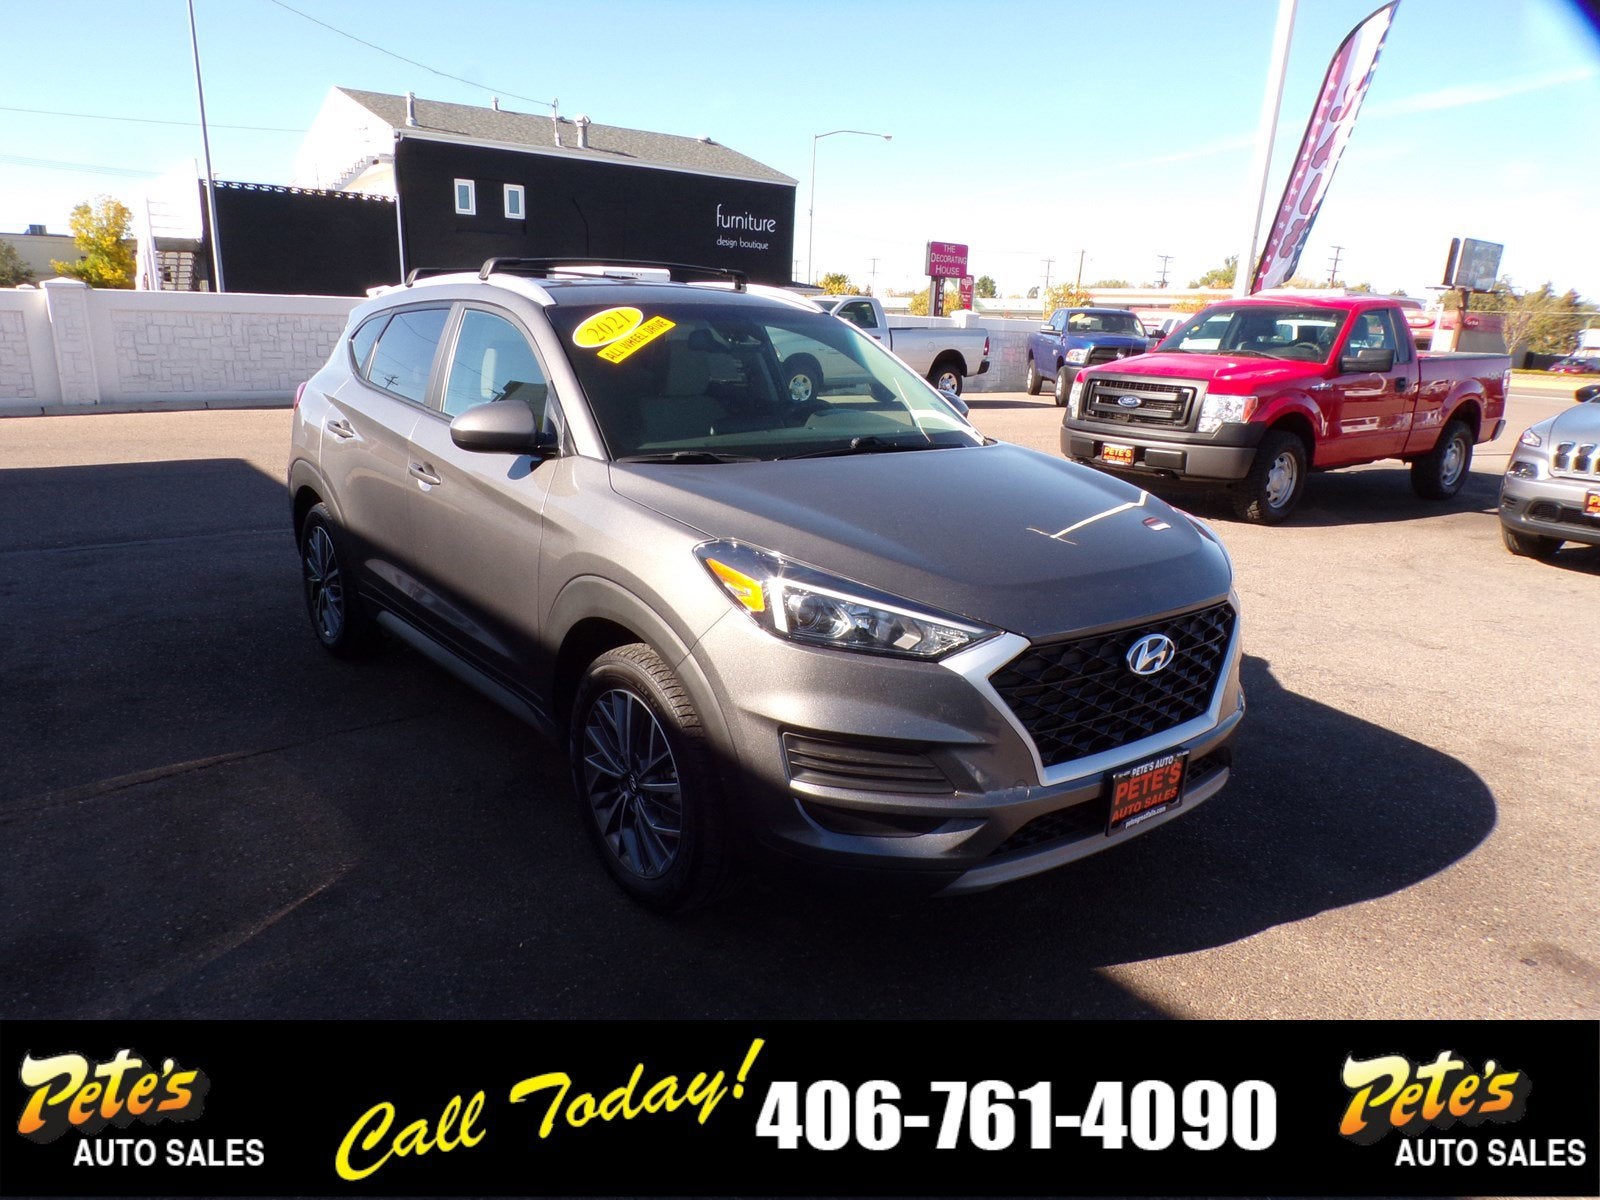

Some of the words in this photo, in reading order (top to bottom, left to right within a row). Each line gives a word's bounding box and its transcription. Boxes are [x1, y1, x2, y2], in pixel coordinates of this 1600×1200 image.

[716, 203, 777, 233] furniture
[716, 235, 738, 249] design
[739, 236, 769, 251] boutique
[943, 244, 956, 254] THE
[930, 252, 968, 265] DECORATING
[935, 264, 960, 276] HOUSE
[586, 311, 631, 342] 2021
[605, 346, 625, 361] ALL
[621, 329, 648, 350] WHEEL
[642, 319, 668, 337] DRIVE
[1103, 446, 1132, 458] PETE'S
[1131, 762, 1155, 777] PETE'S
[1154, 755, 1174, 770] AUTO
[1114, 761, 1184, 806] PETE'S
[1111, 801, 1142, 822] AUTO
[1145, 787, 1178, 809] SALES
